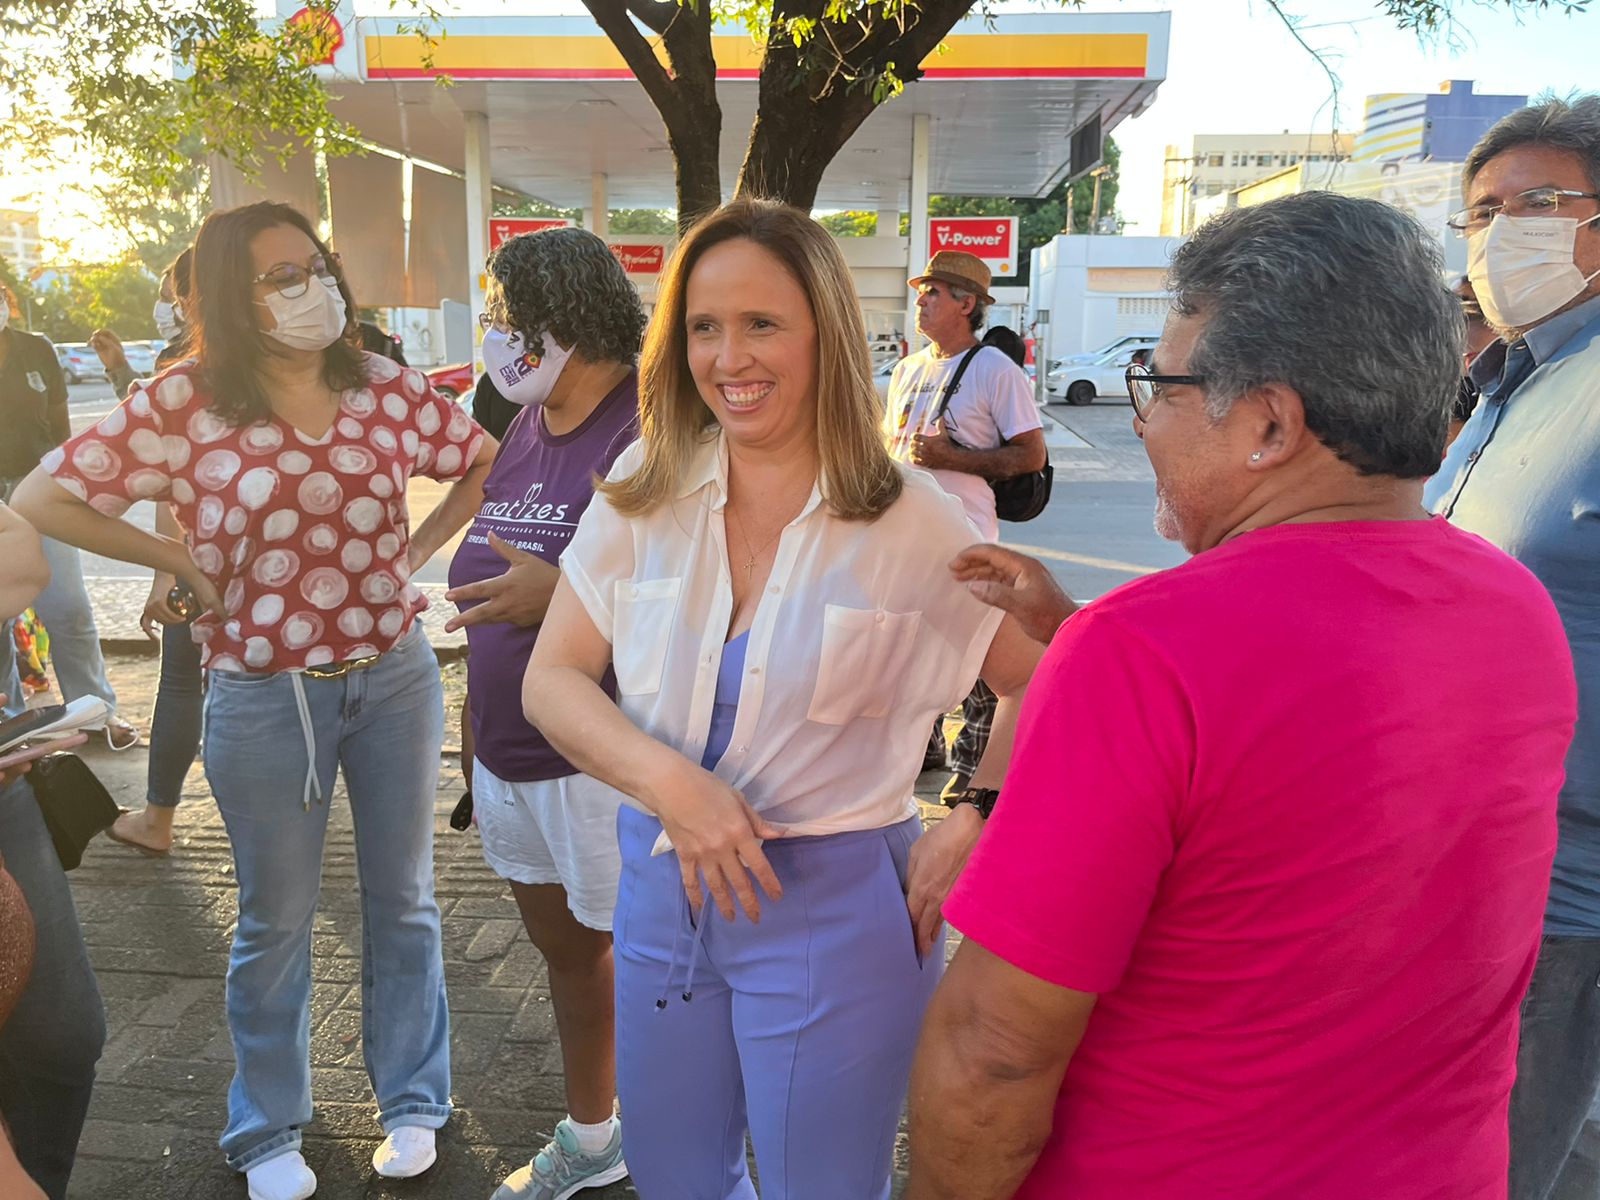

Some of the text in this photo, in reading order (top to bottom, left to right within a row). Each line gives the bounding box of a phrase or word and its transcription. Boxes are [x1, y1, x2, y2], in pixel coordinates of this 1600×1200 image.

[937, 232, 1002, 246] V-Power
[481, 499, 569, 521] matizes
[516, 541, 545, 552] BRASIL
